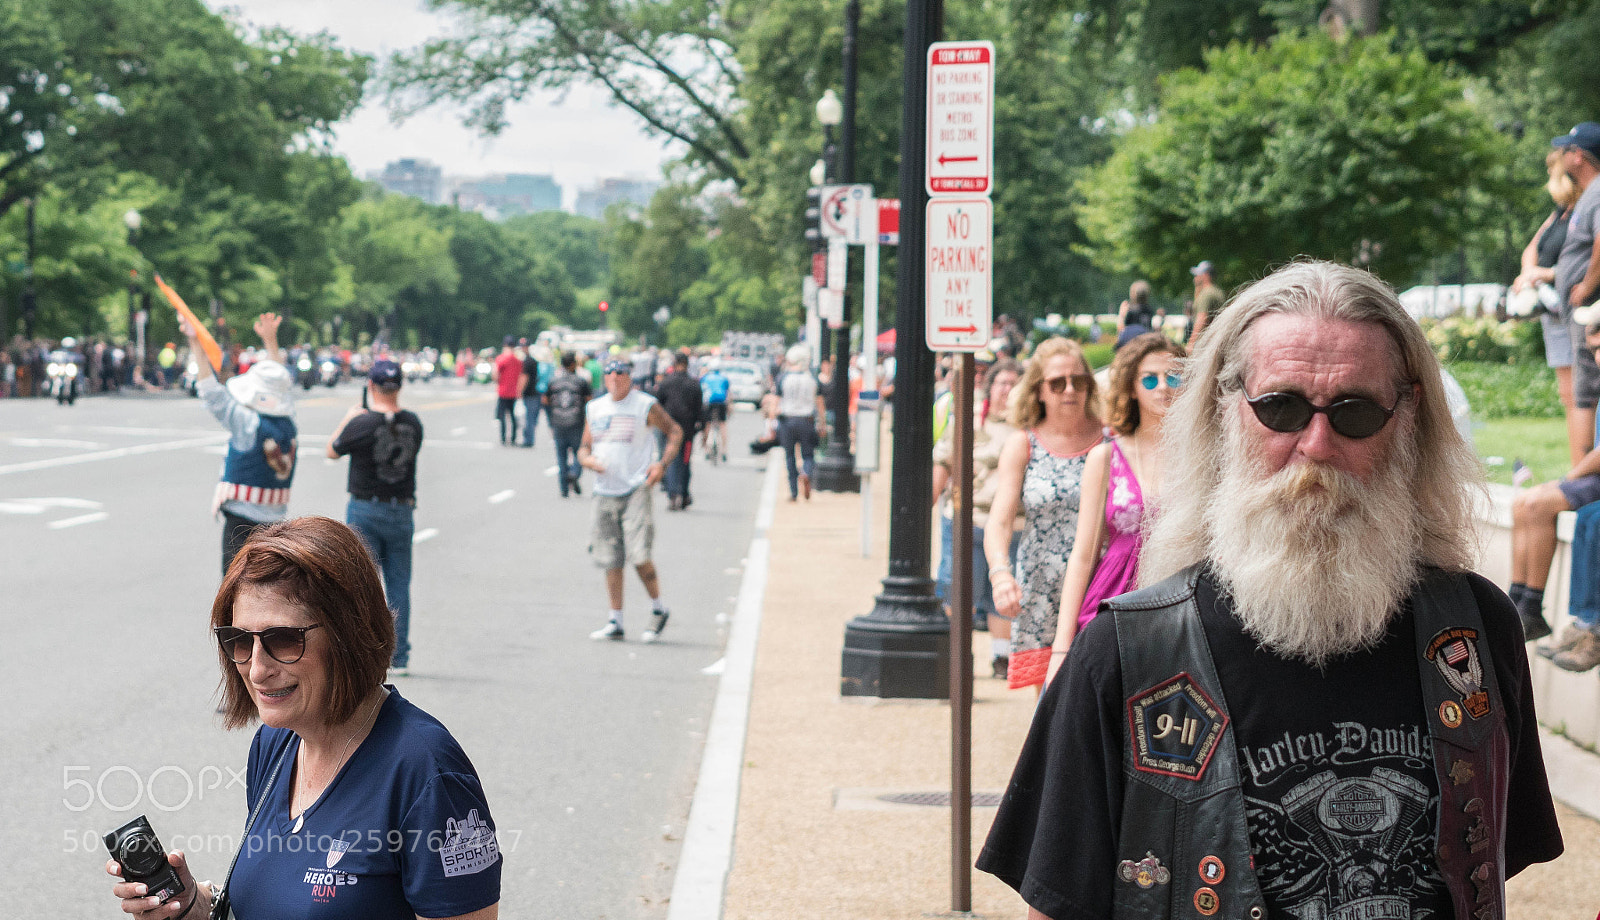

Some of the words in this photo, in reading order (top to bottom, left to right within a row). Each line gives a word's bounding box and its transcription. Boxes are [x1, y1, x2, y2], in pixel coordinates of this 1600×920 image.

[938, 50, 956, 63] TOW
[957, 49, 982, 62] AWAY
[936, 72, 946, 85] NO
[949, 71, 982, 84] PARKING
[936, 93, 946, 105] OR
[948, 91, 983, 105] STANDING
[946, 112, 973, 125] METRO
[939, 129, 955, 142] BUS
[957, 128, 978, 141] ZONE
[947, 213, 970, 240] NO
[931, 246, 985, 273] PARKING
[946, 277, 970, 295] ANY
[944, 299, 973, 318] TIME
[444, 841, 496, 867] SPORTS
[447, 853, 497, 874] COMMISSION
[303, 871, 358, 886] HEROES
[311, 884, 337, 898] RUN
[1365, 900, 1376, 918] to
[1382, 899, 1408, 919] Live
